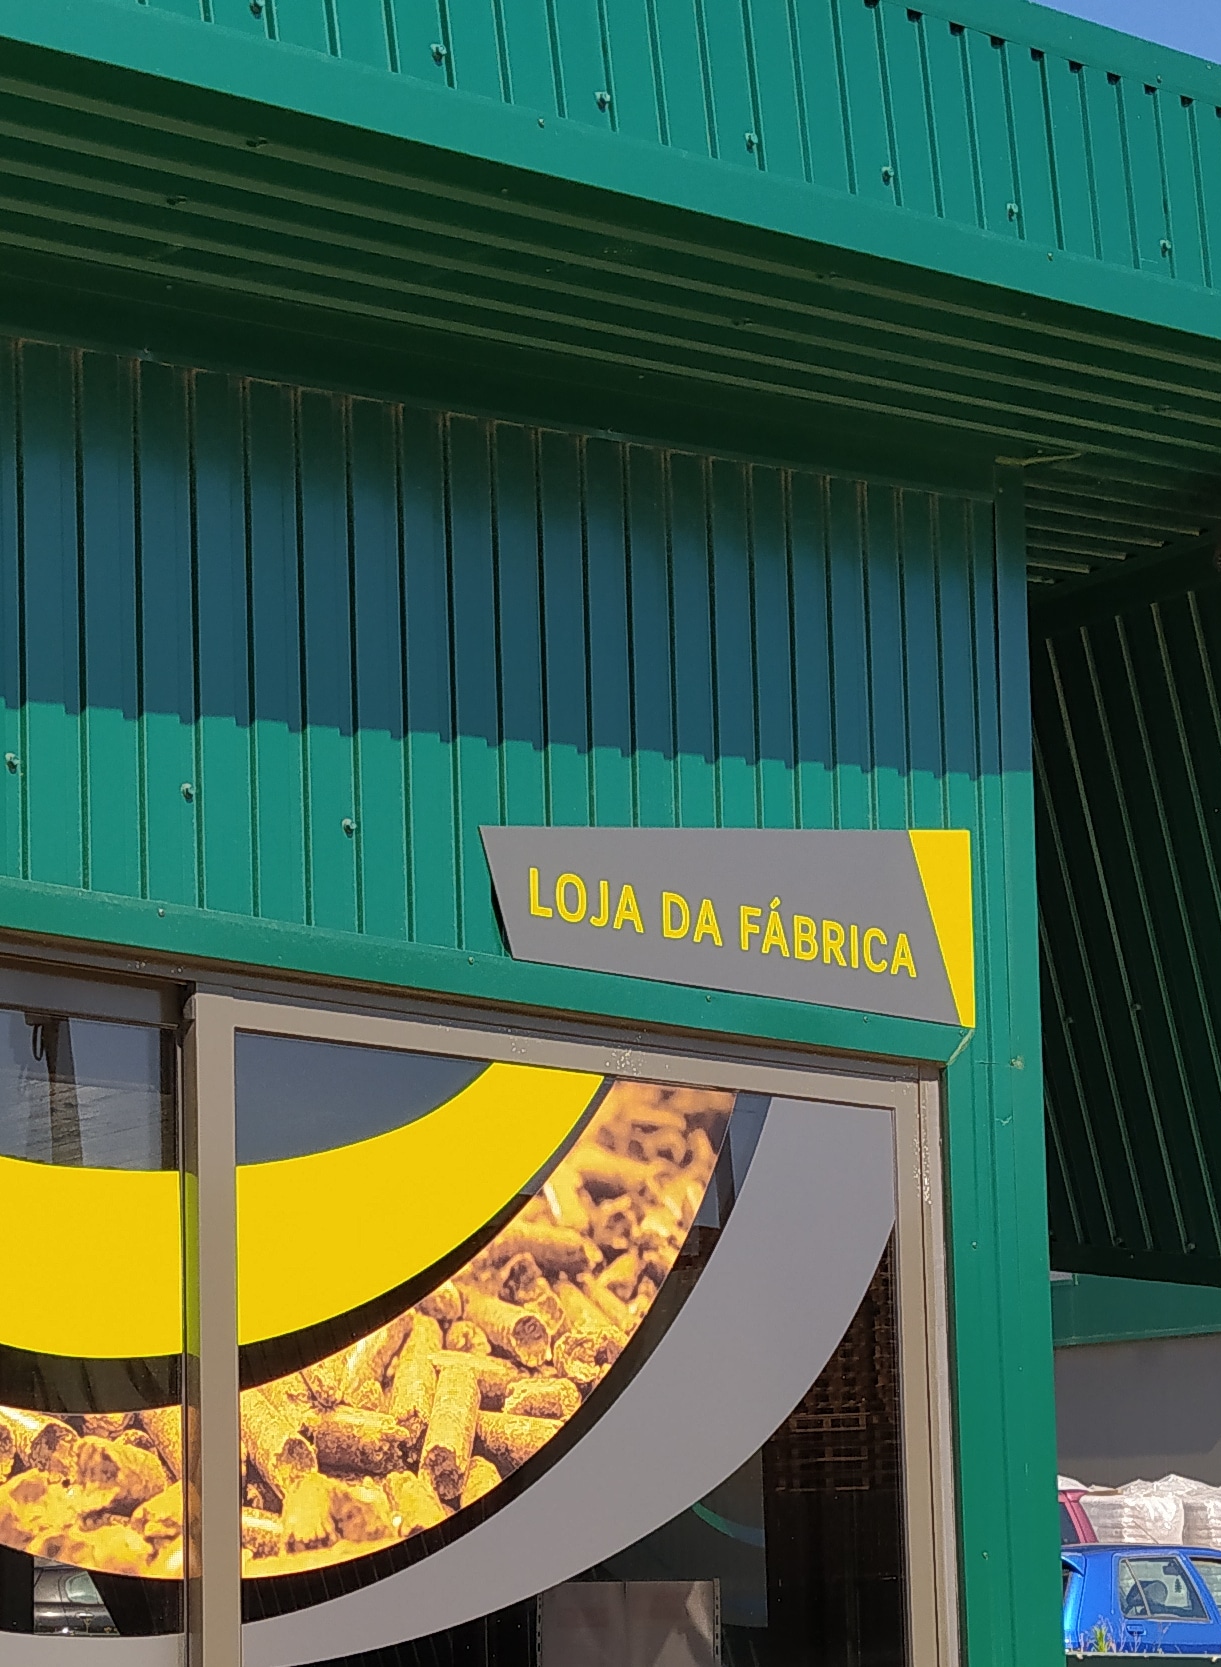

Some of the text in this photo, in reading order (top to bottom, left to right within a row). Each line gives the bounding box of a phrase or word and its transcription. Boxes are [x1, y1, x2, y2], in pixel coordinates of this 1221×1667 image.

[529, 867, 918, 978] LOJA DA FÁBRICA
